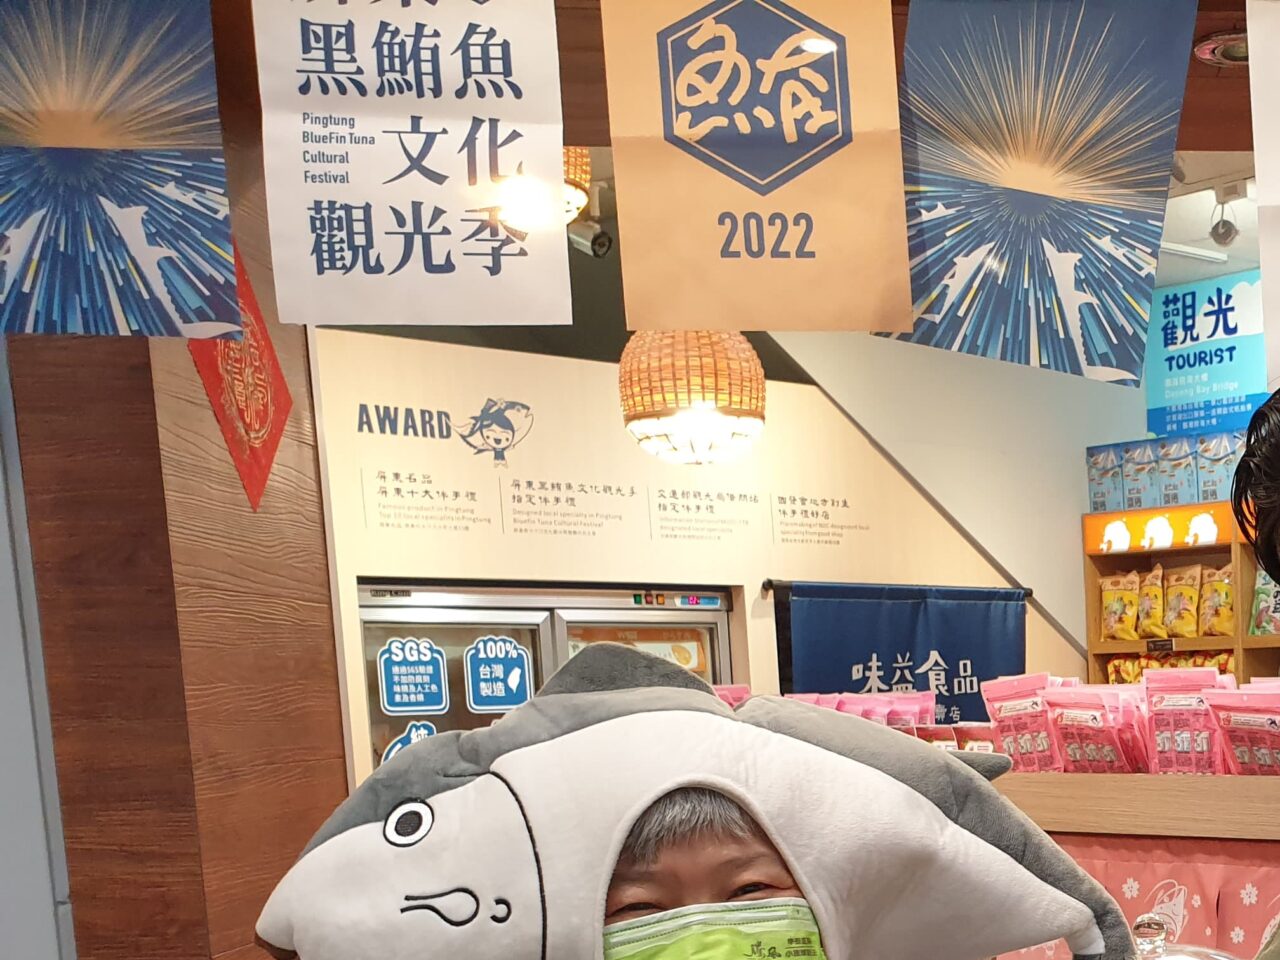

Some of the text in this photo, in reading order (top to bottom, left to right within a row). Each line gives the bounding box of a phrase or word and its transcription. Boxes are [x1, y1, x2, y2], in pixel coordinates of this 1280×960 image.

[296, 19, 524, 100] 黑鮪魚
[302, 113, 355, 130] Pingtung
[302, 131, 376, 147] BlueFin Tuna
[303, 151, 349, 165] Cultural
[382, 116, 524, 186] 文化
[304, 170, 350, 185] Festival
[307, 201, 529, 276] 觀光季
[718, 212, 816, 259] 2022
[1161, 287, 1238, 348] 觀光
[1164, 346, 1236, 371] TOURIST
[357, 403, 453, 440] AWARD
[390, 641, 433, 662] SGS
[477, 641, 518, 658] 100%
[479, 664, 504, 679] 台灣
[851, 650, 979, 695] 味益食品
[479, 681, 506, 697] 製造
